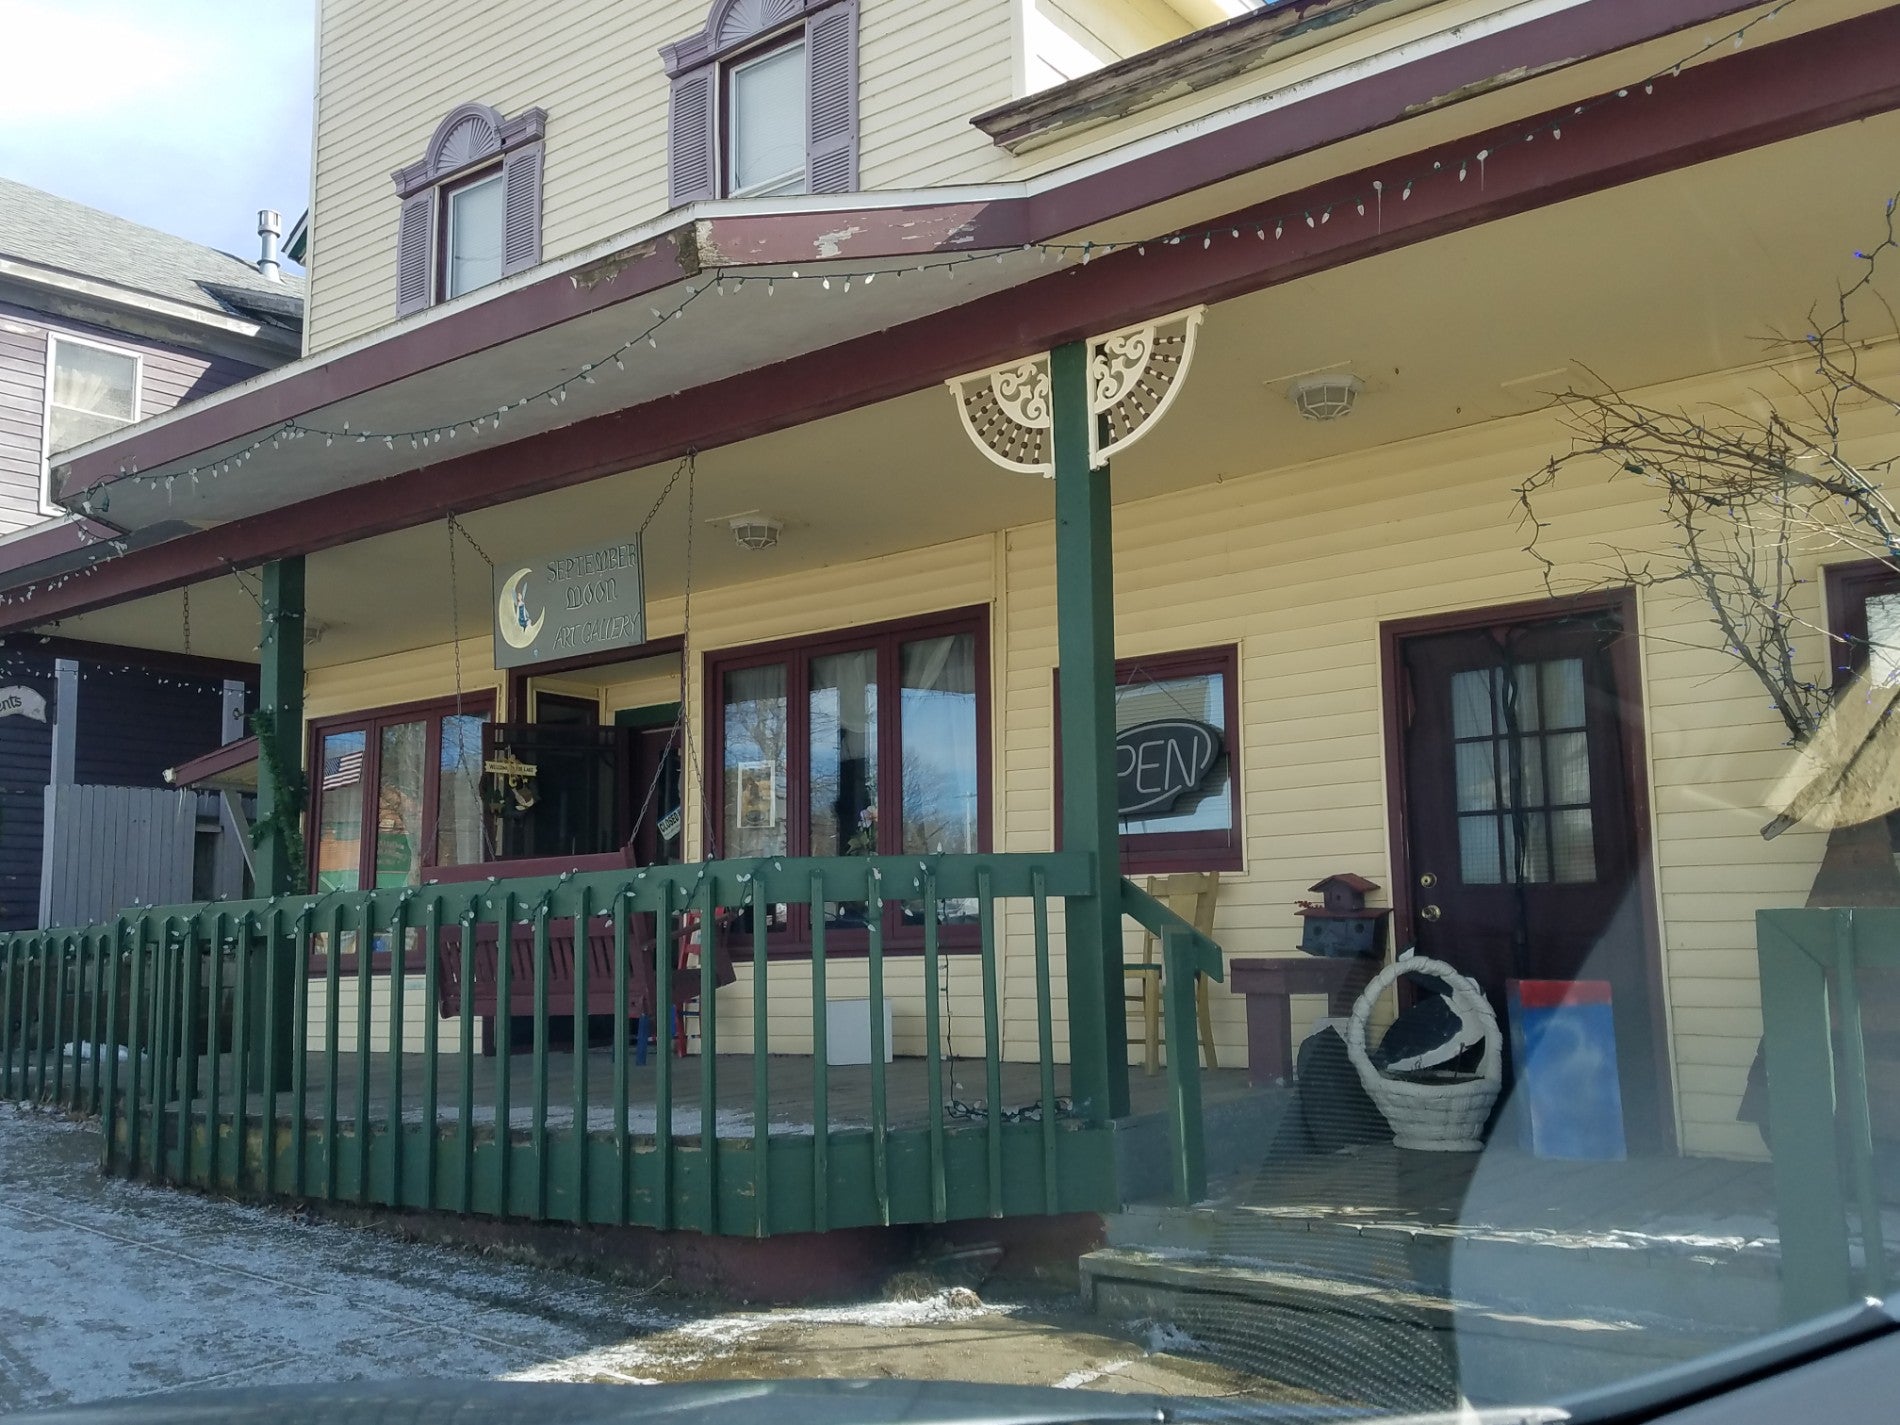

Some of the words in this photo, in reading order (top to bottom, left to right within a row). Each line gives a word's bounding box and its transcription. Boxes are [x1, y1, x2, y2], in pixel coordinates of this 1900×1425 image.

[547, 543, 636, 582] SEPTEMBER
[566, 577, 618, 610] MOON
[552, 622, 580, 650] ART
[581, 612, 641, 644] GALLERY
[0, 693, 22, 712] nts
[1116, 736, 1198, 793] PEN
